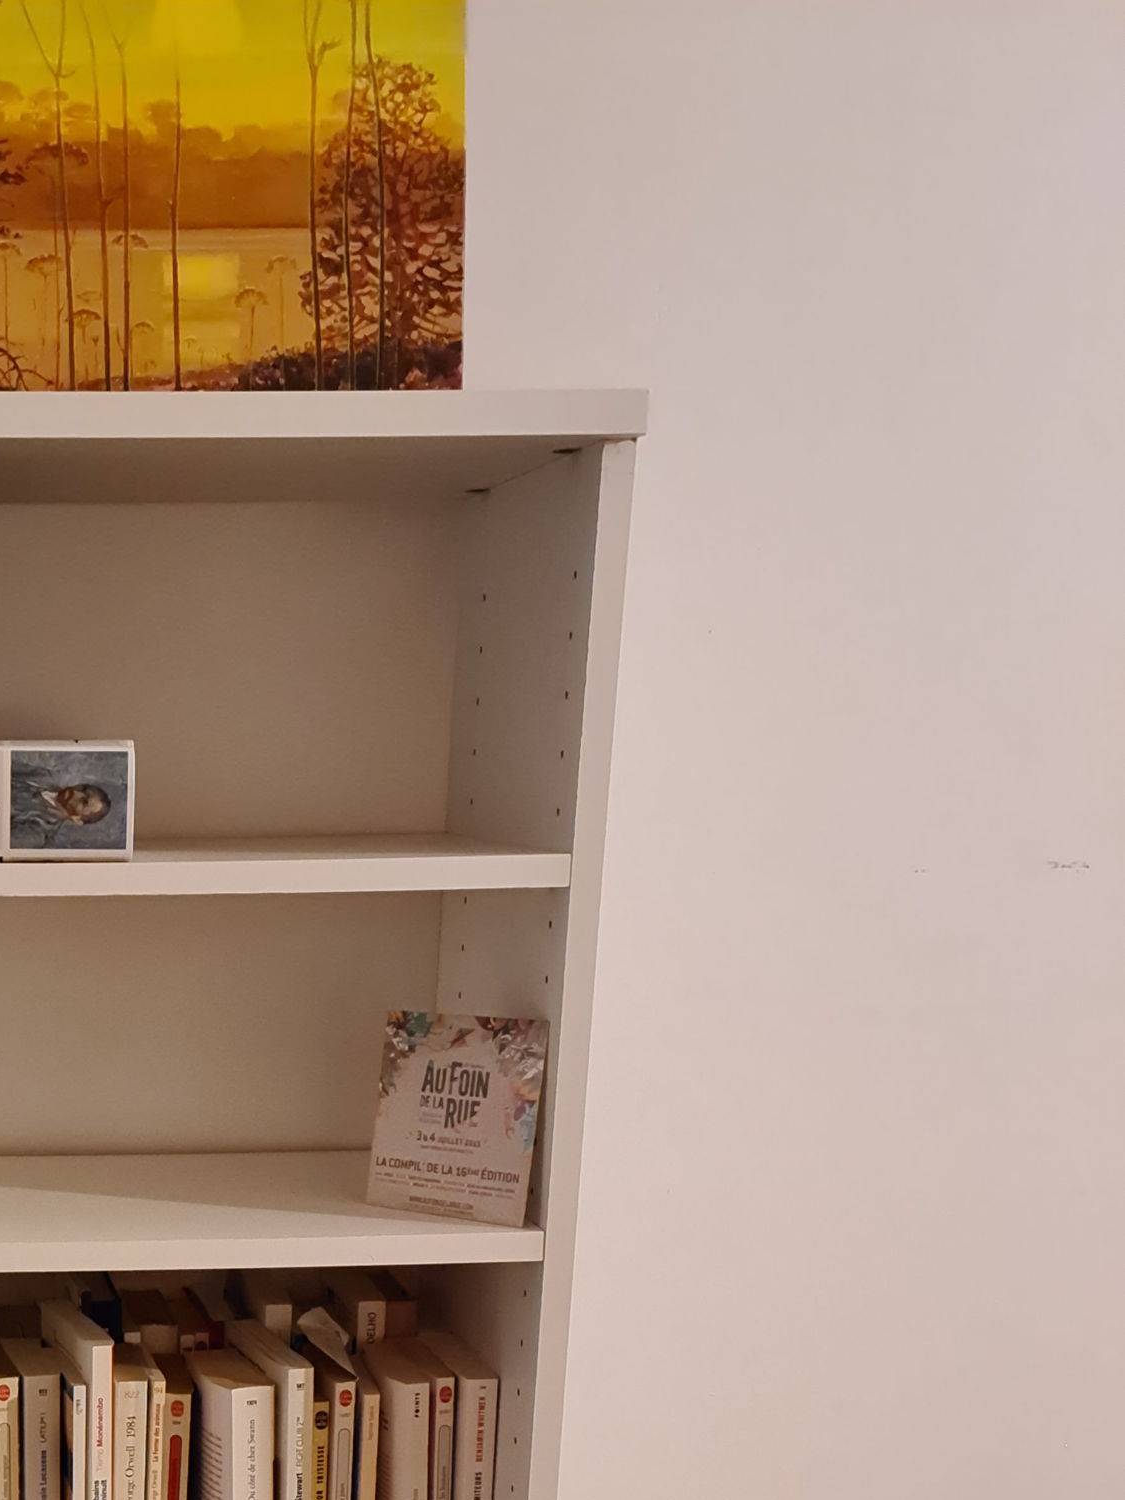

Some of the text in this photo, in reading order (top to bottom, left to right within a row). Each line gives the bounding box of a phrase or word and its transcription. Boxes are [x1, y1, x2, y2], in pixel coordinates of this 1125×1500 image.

[448, 1061, 490, 1098] FOIN
[444, 1098, 481, 1128] RUE
[376, 1156, 386, 1166] LA
[427, 1162, 439, 1174] DE
[441, 1165, 453, 1175] LA
[481, 1168, 520, 1183] ÉDITION
[96, 1397, 104, 1447] Monénembo
[126, 1415, 136, 1438] 1984
[246, 1419, 255, 1444] Swann
[123, 1446, 136, 1478] Orwell
[247, 1464, 255, 1473] de
